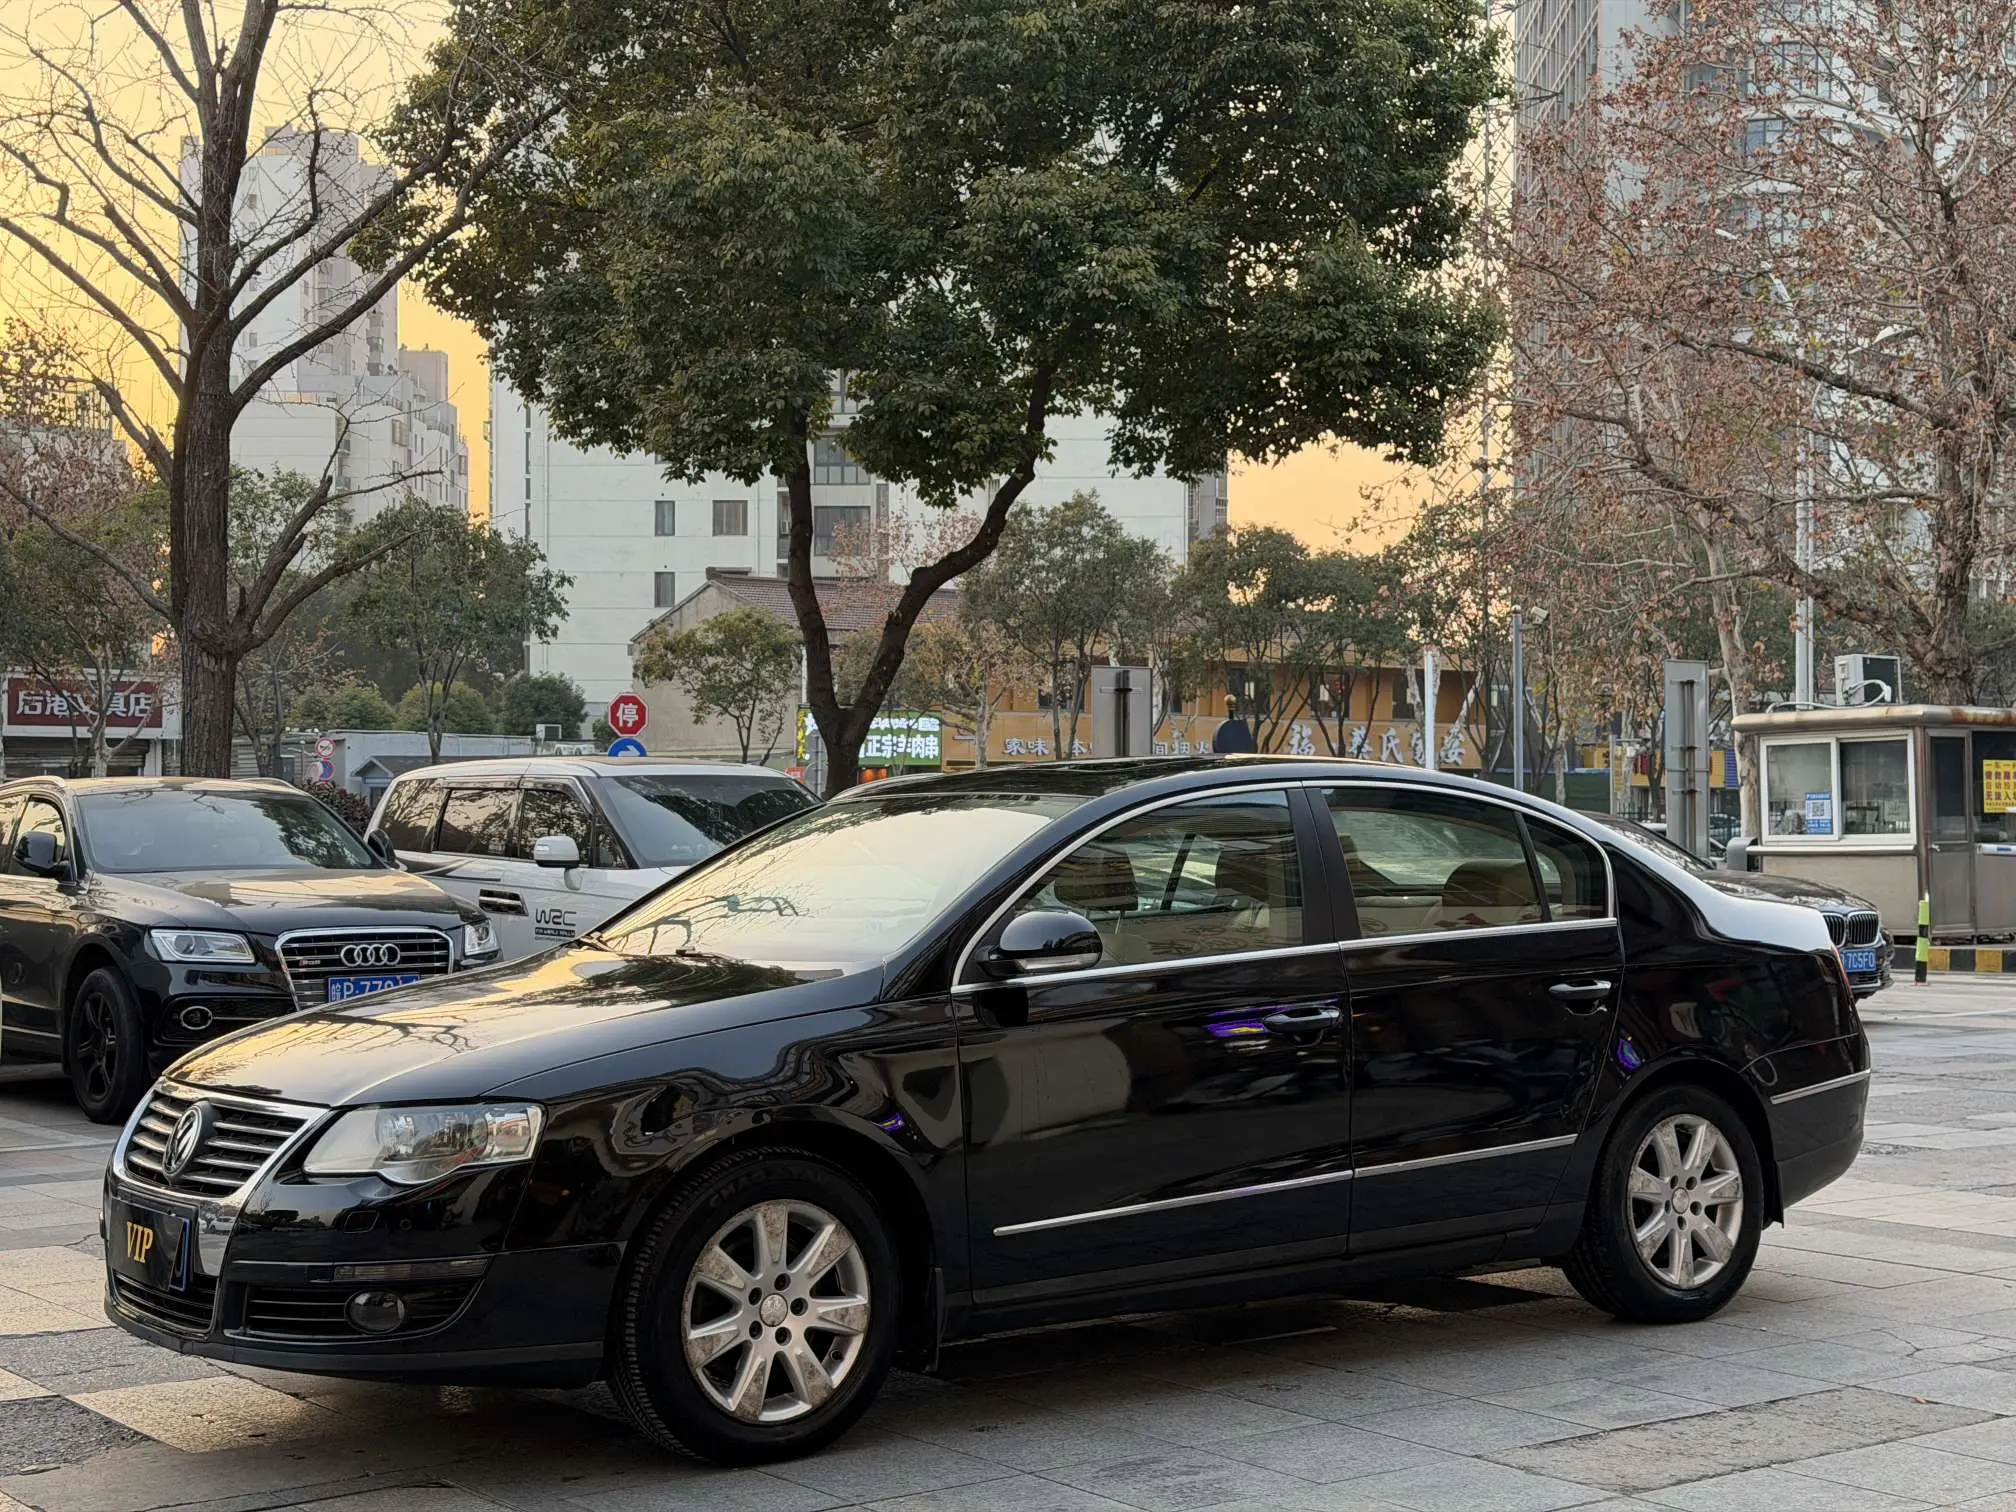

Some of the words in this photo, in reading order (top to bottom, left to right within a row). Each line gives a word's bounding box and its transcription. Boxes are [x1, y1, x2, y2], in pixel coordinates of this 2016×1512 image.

[616, 702, 639, 728] 停
[859, 734, 939, 759] 正宗羊肉串
[535, 908, 577, 926] WRC
[126, 1221, 154, 1264] VIP
